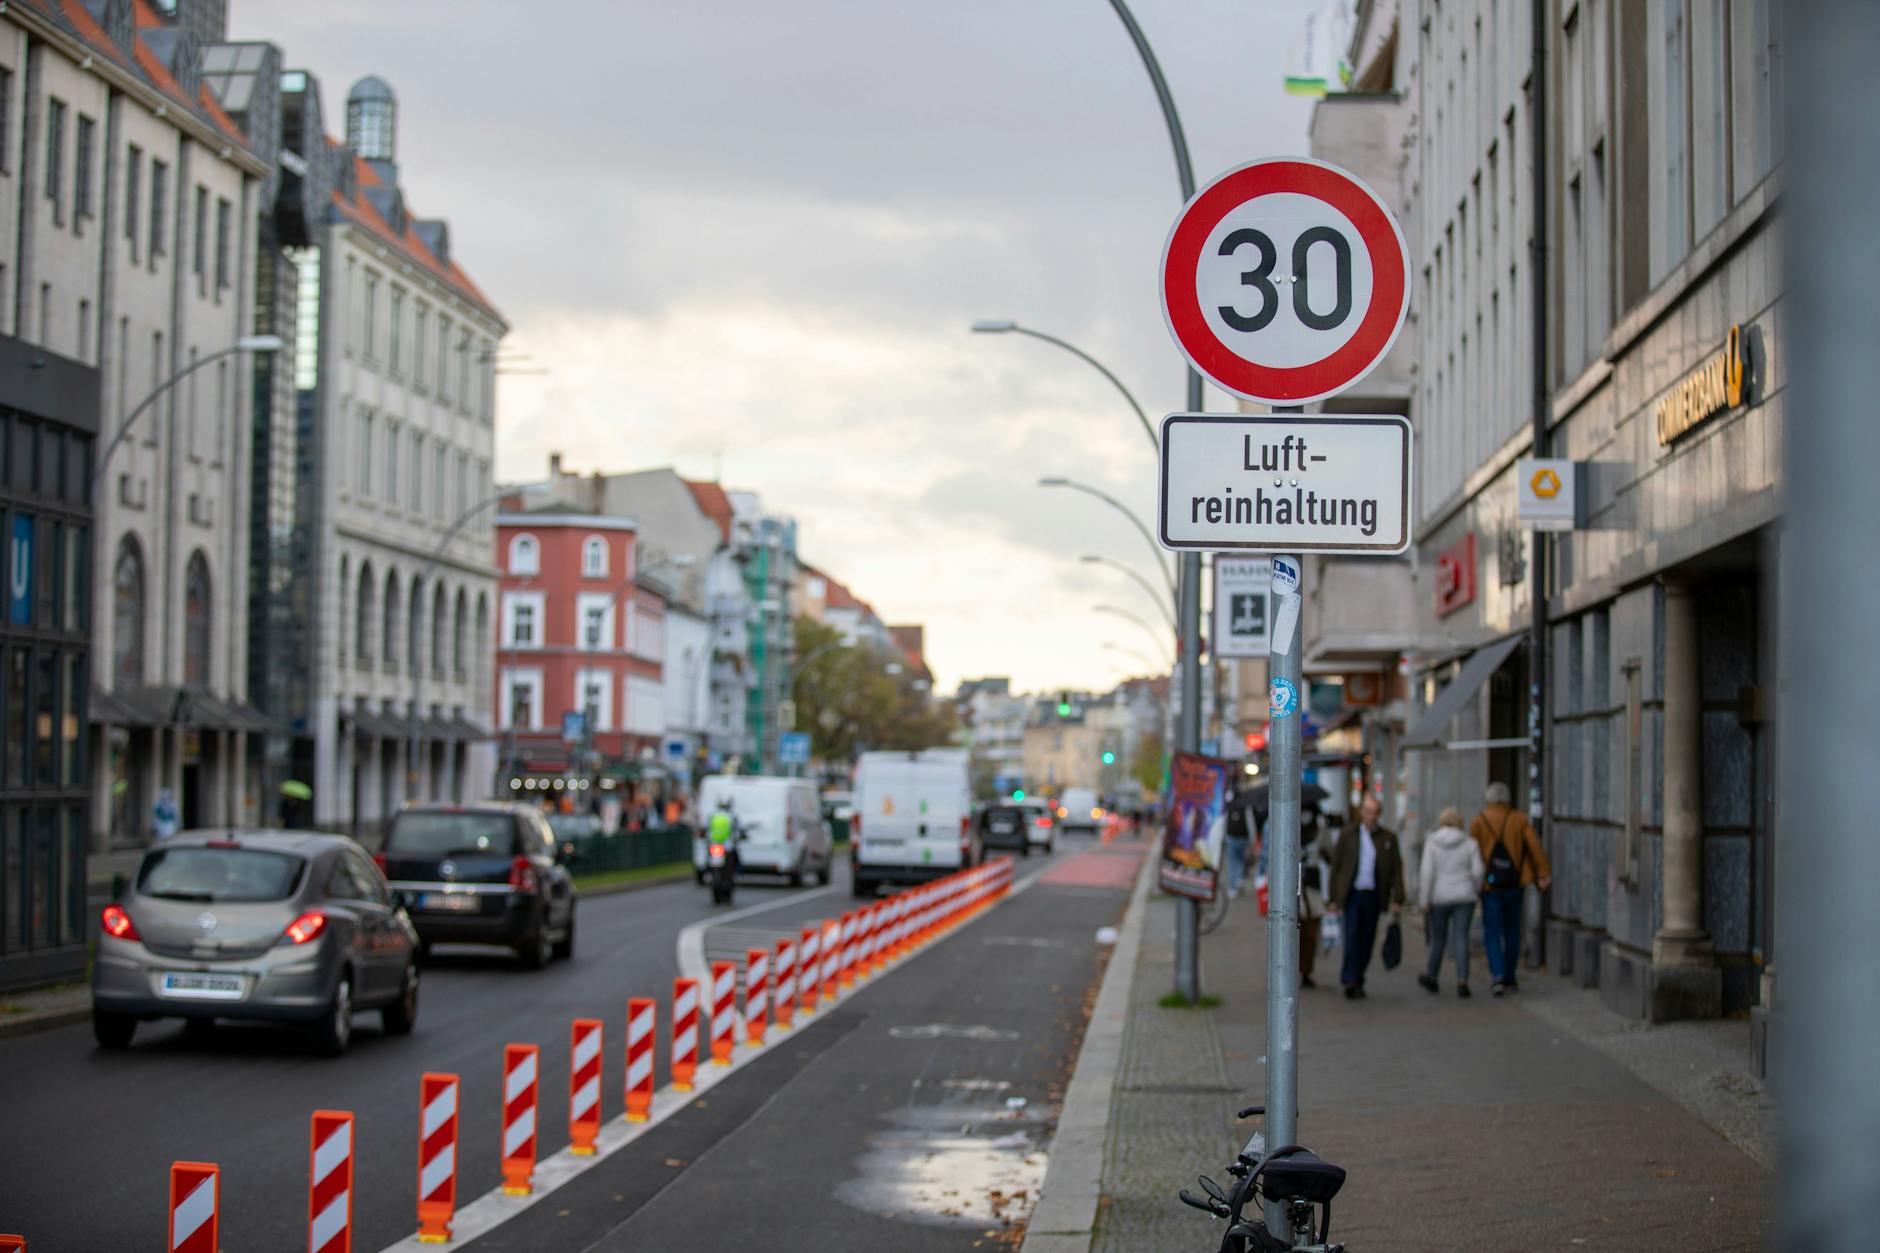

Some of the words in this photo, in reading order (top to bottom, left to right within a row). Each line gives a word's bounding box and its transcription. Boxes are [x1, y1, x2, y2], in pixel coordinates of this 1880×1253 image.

[1217, 225, 1353, 333] 30
[1657, 351, 1727, 446] COMMERZBANK
[1243, 434, 1327, 472] Luft-
[1191, 488, 1378, 537] reinhaltung
[10, 538, 29, 599] U
